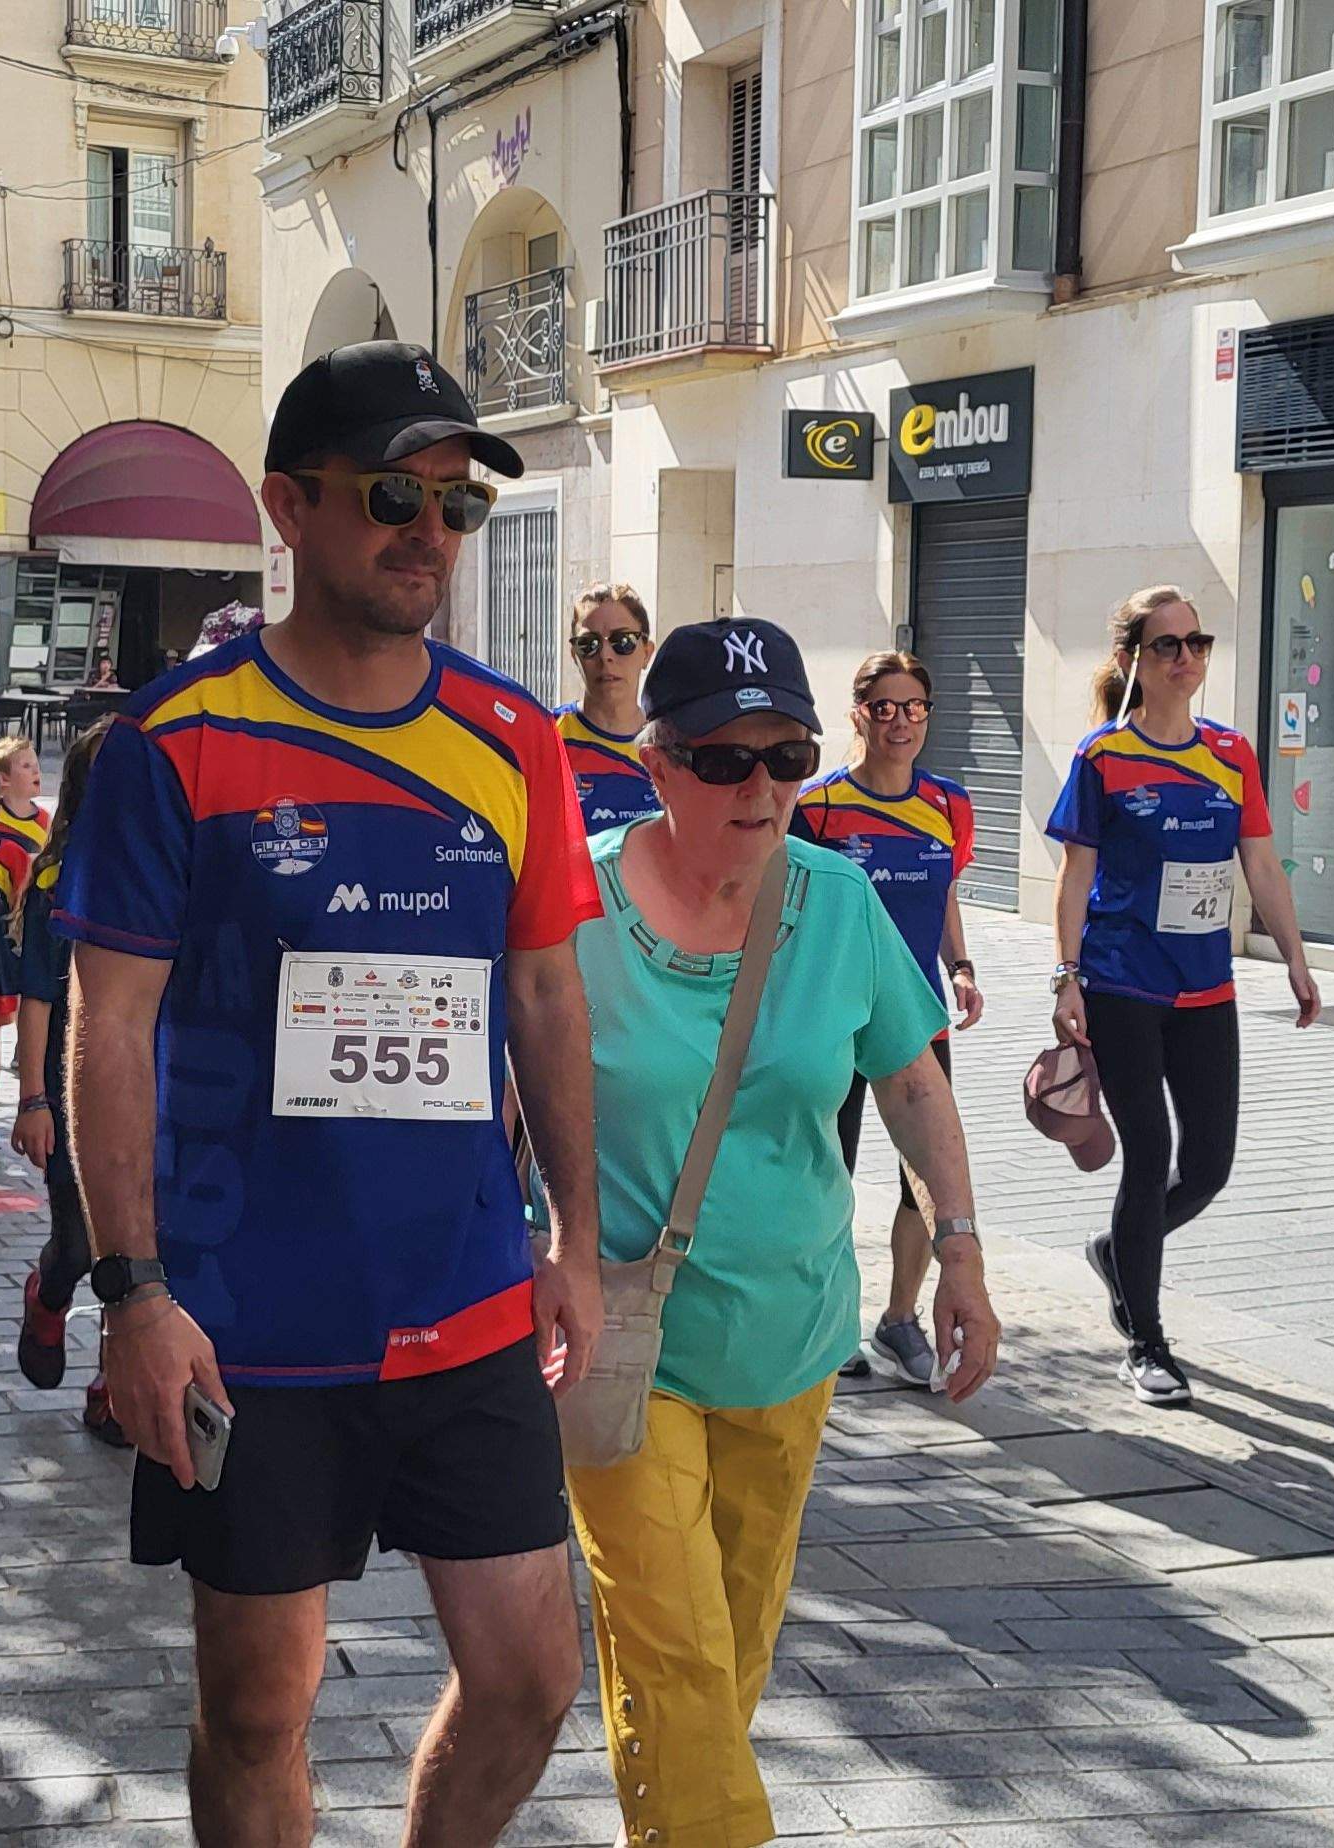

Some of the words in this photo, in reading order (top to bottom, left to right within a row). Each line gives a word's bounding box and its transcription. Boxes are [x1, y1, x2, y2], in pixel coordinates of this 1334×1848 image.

[900, 392, 1010, 455] embou
[722, 630, 768, 674] NY
[254, 841, 292, 854] RUTA
[299, 838, 326, 849] 091
[379, 885, 449, 916] mupol
[1191, 896, 1218, 920] 42
[329, 1034, 450, 1086] 555
[286, 1096, 339, 1108] #RUTA091
